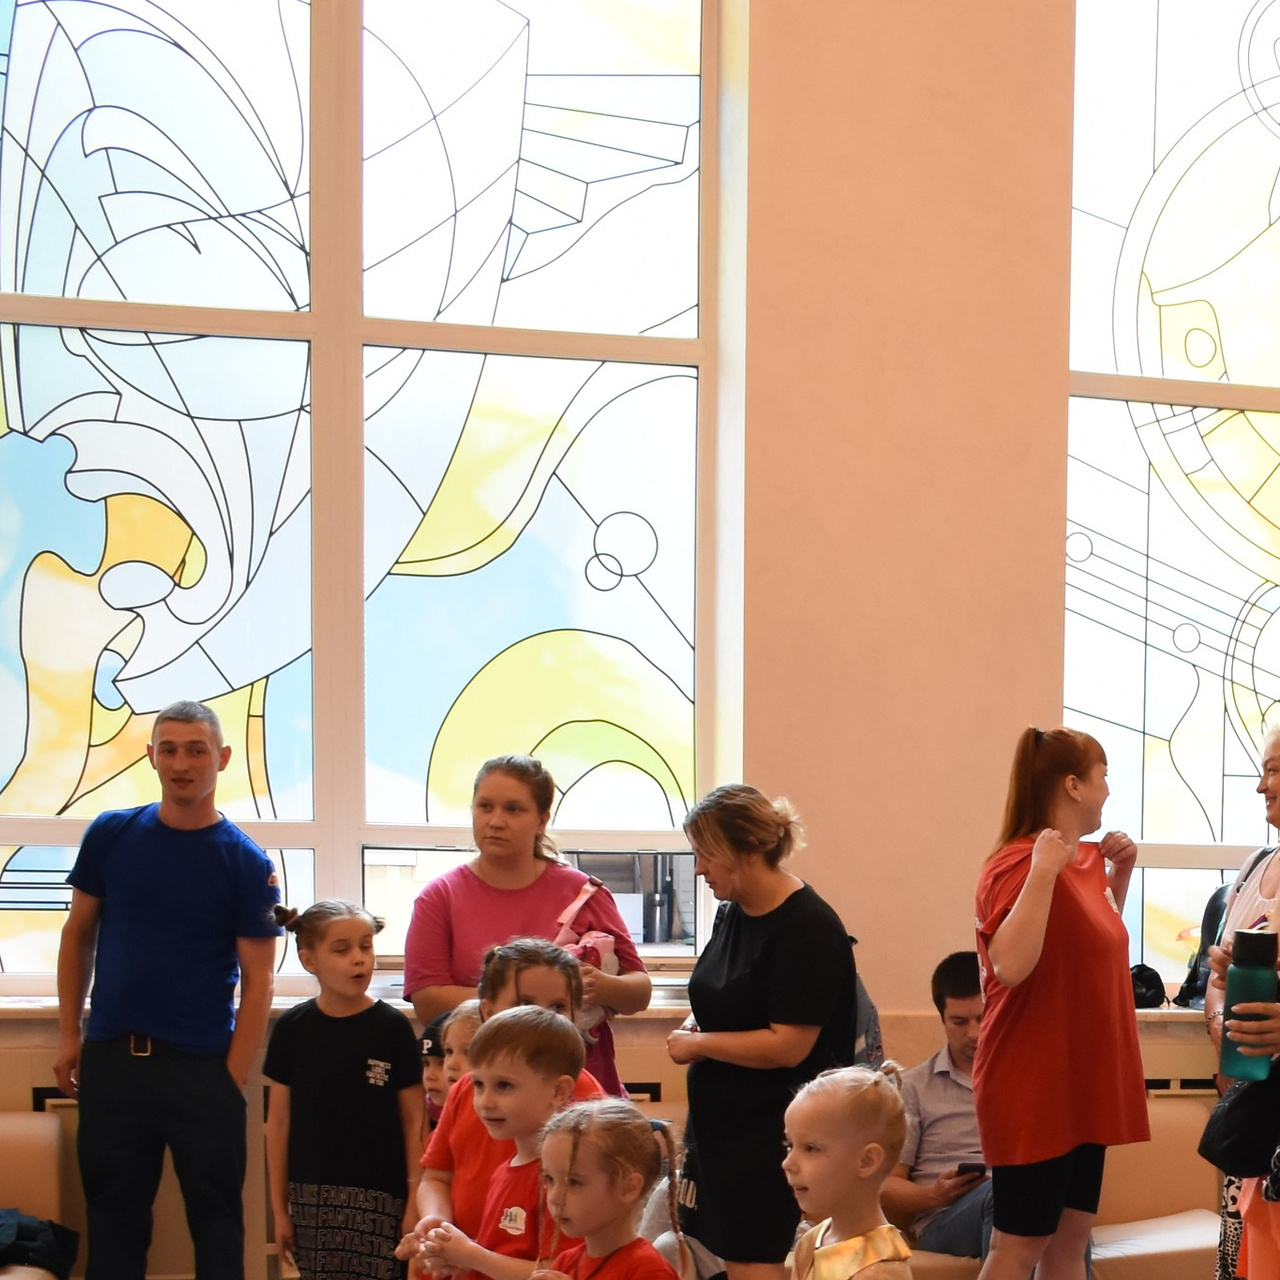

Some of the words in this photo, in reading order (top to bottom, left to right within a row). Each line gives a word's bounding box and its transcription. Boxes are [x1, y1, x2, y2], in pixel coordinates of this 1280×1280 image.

[422, 1039, 433, 1054] P
[317, 1206, 397, 1238] FANTASTIC
[317, 1229, 395, 1259] FANTASTIC
[316, 1251, 394, 1280] FANTASTIC
